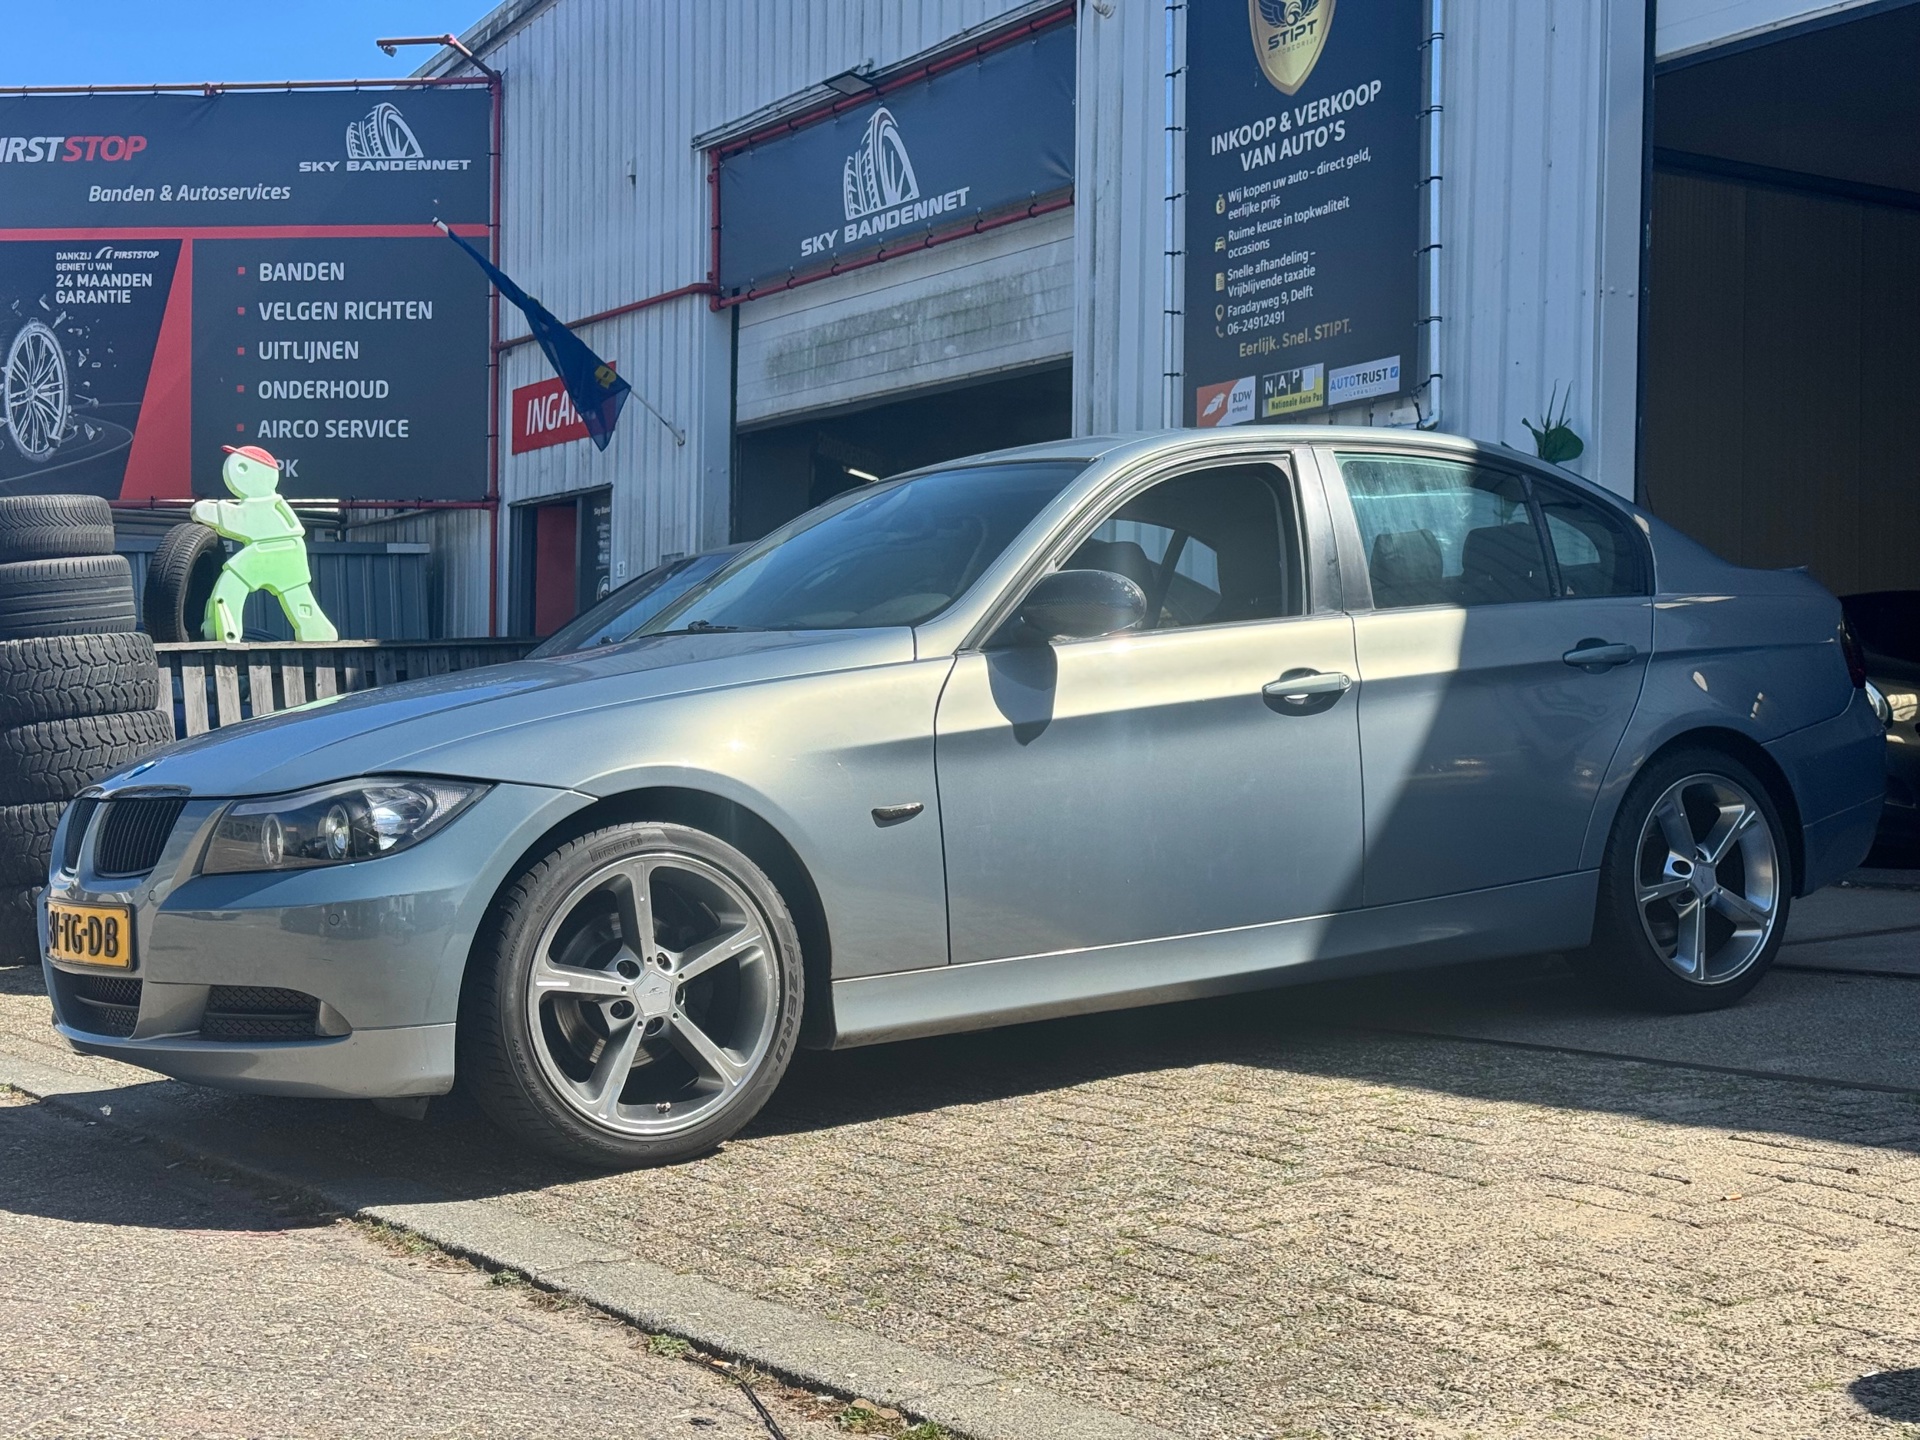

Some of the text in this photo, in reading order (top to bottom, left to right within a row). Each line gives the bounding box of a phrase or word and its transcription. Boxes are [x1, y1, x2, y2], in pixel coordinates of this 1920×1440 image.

[1268, 18, 1318, 51] STIPT
[1211, 79, 1382, 155] INKOOP & VERKOOP
[1240, 120, 1346, 172] VAN AUTO'S
[299, 159, 472, 172] SKY BANDENNET
[1228, 187, 1242, 203] Wij
[1243, 181, 1272, 199] kopen
[1273, 176, 1287, 190] uw
[1287, 170, 1309, 185] auto
[1317, 156, 1345, 176] direct
[1347, 147, 1372, 169] geld,
[89, 183, 291, 202] Banden & Autoservices
[1228, 194, 1281, 220] eerlijke prijs
[801, 186, 970, 257] SKY BANDENNET
[1228, 196, 1350, 242] Ruime keuze in topkwaliteit
[56, 250, 159, 261] DANKZIJ FIRSTSTOP
[1228, 238, 1270, 259] occasions
[56, 262, 112, 271] GENIET U VAN
[259, 262, 345, 282] BANDEN
[1227, 263, 1254, 281] Snelle
[1255, 250, 1309, 274] afhandeling
[56, 273, 152, 287] 24 MAANDEN
[1228, 264, 1316, 298] Vrijblijvende taxatie
[56, 290, 131, 304] GARANTIE
[1227, 285, 1314, 318] Faradayweg 9, Delft
[259, 300, 433, 321] VELGEN RICHTEN
[1227, 310, 1285, 336] 06-24912491
[1239, 318, 1352, 358] Eerlijk. Snel. STIPT.
[258, 340, 359, 363] UITLIJNEN
[258, 380, 389, 400] ONDERHOUD
[1330, 368, 1388, 392] AUTOTRUST
[1232, 389, 1252, 404] RDW
[1271, 397, 1298, 410] Nationale
[1299, 395, 1312, 404] Auto
[257, 418, 409, 439] AIRCO SERVICE
